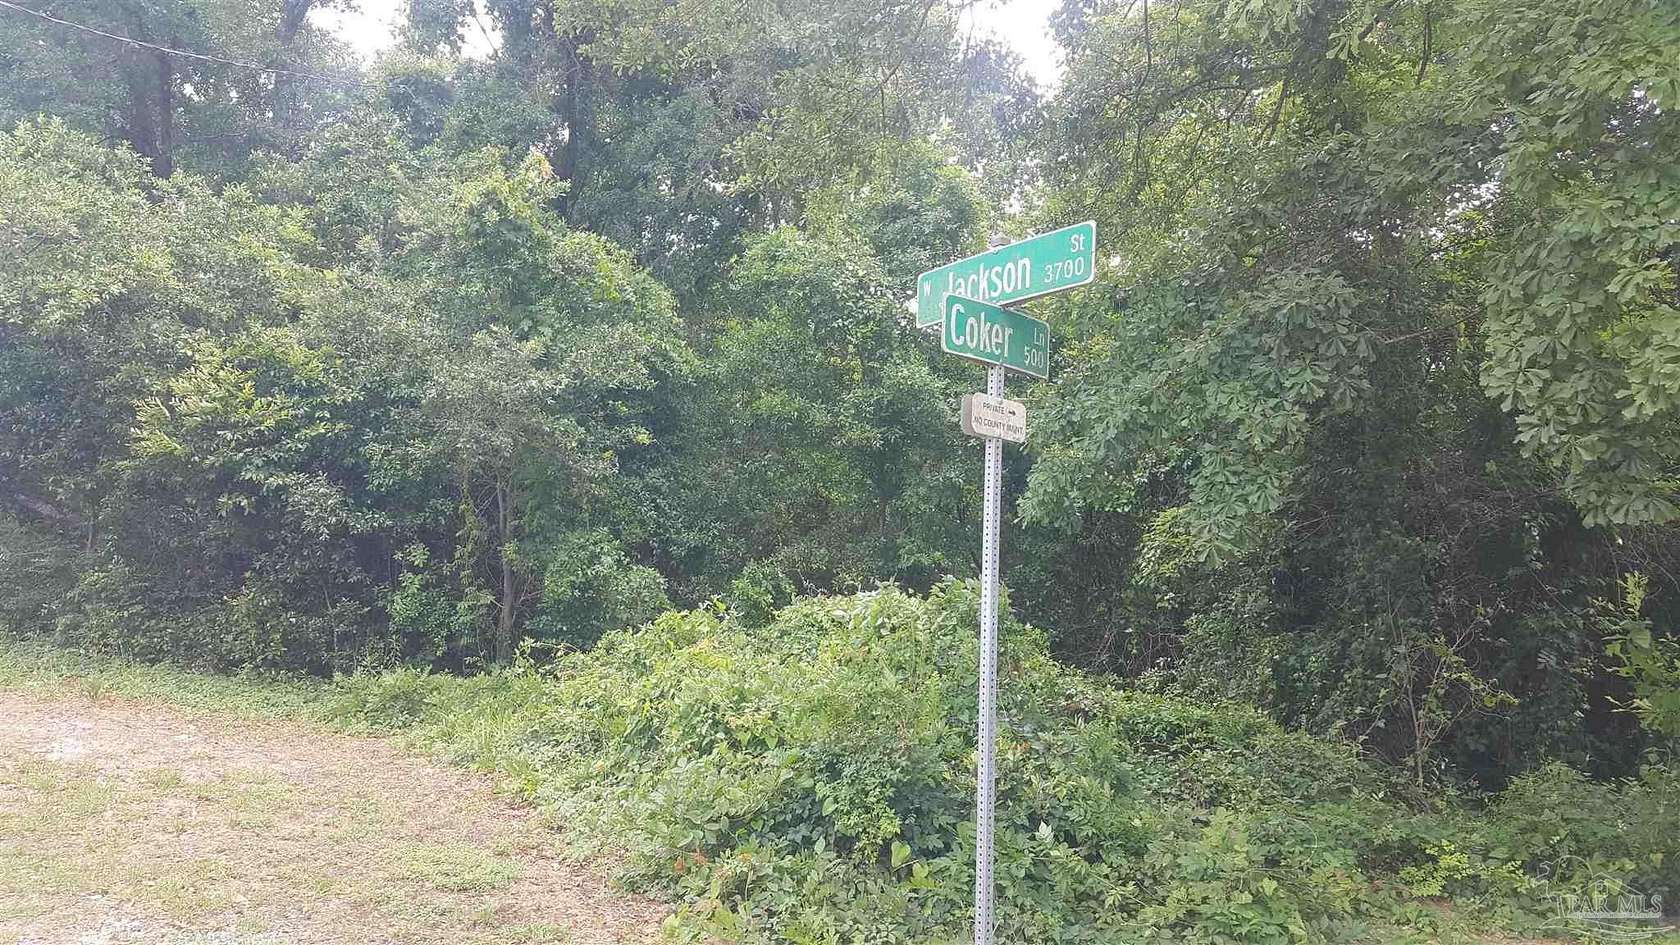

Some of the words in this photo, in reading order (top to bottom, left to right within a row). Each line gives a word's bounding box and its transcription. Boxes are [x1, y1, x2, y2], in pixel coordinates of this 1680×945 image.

[1070, 233, 1086, 252] St
[923, 280, 932, 297] W
[1044, 256, 1085, 283] 3700
[951, 304, 1014, 358] Coker
[1034, 327, 1045, 345] Ln
[1023, 346, 1044, 368] 500
[982, 402, 1005, 415] PRIVATE
[983, 418, 1005, 431] COUNTY
